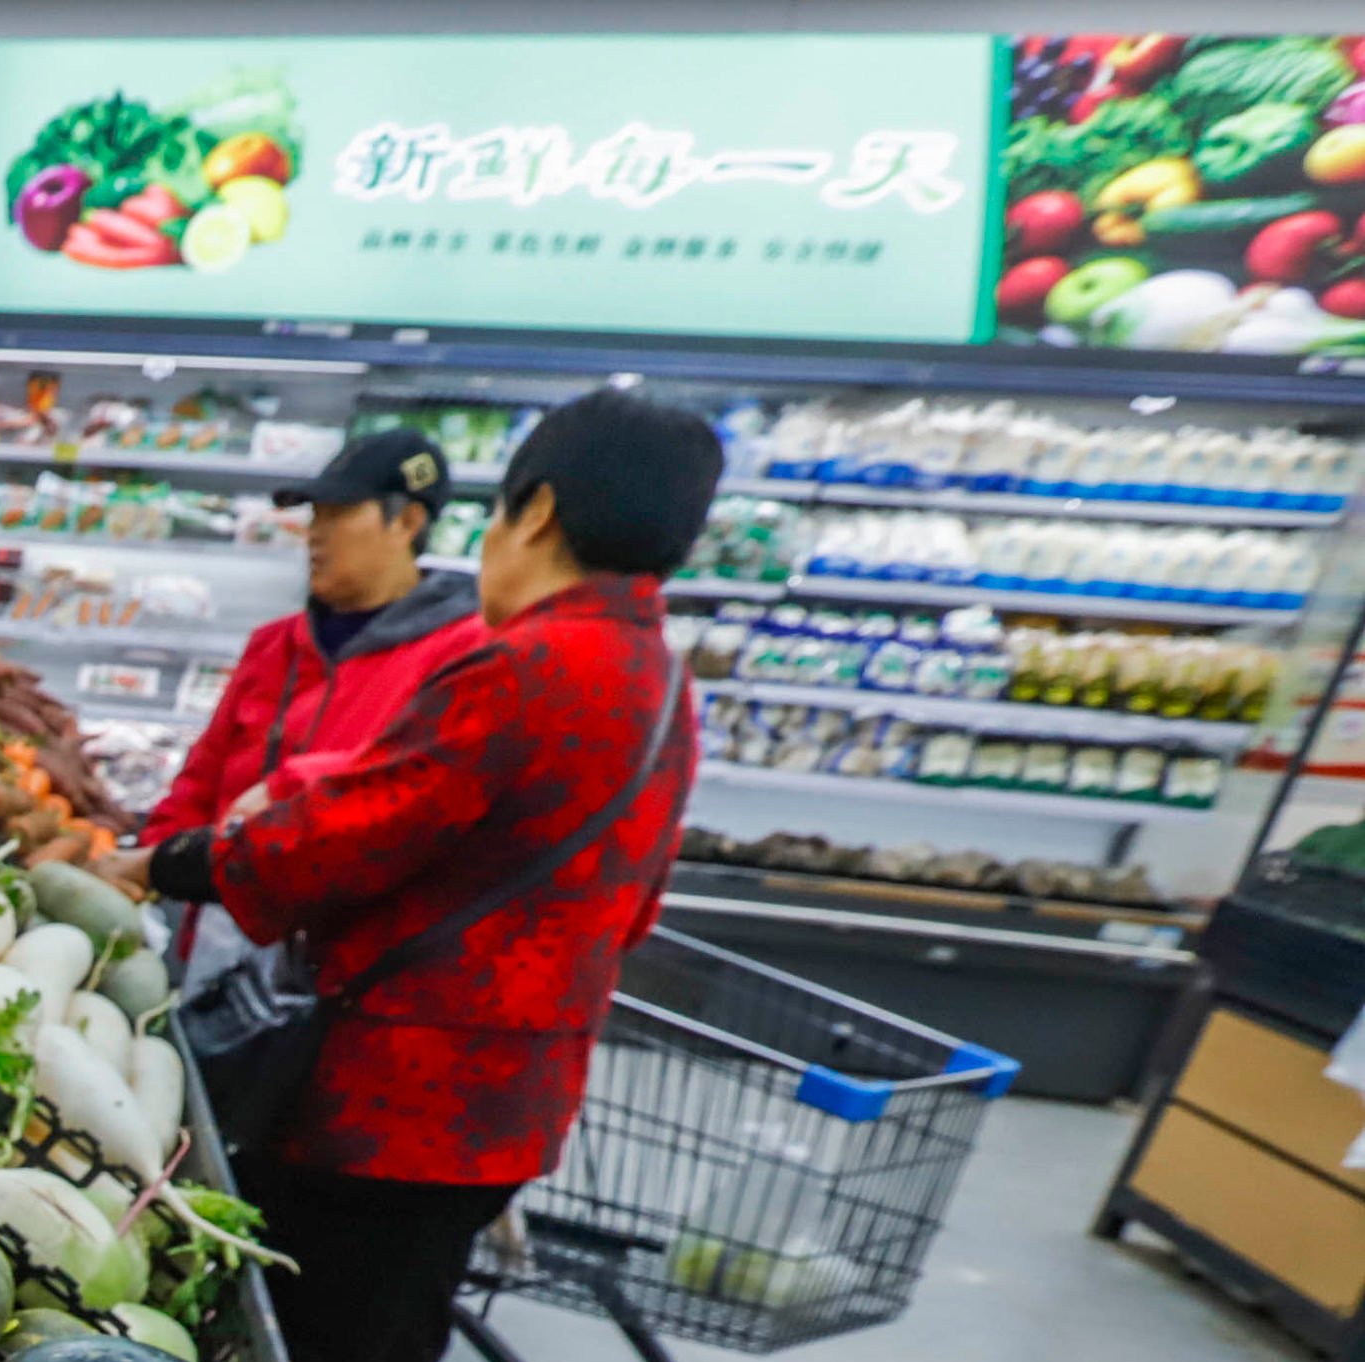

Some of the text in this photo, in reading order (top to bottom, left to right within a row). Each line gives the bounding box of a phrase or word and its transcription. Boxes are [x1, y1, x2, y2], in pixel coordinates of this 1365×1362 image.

[346, 126, 958, 206] 新鲜每一天
